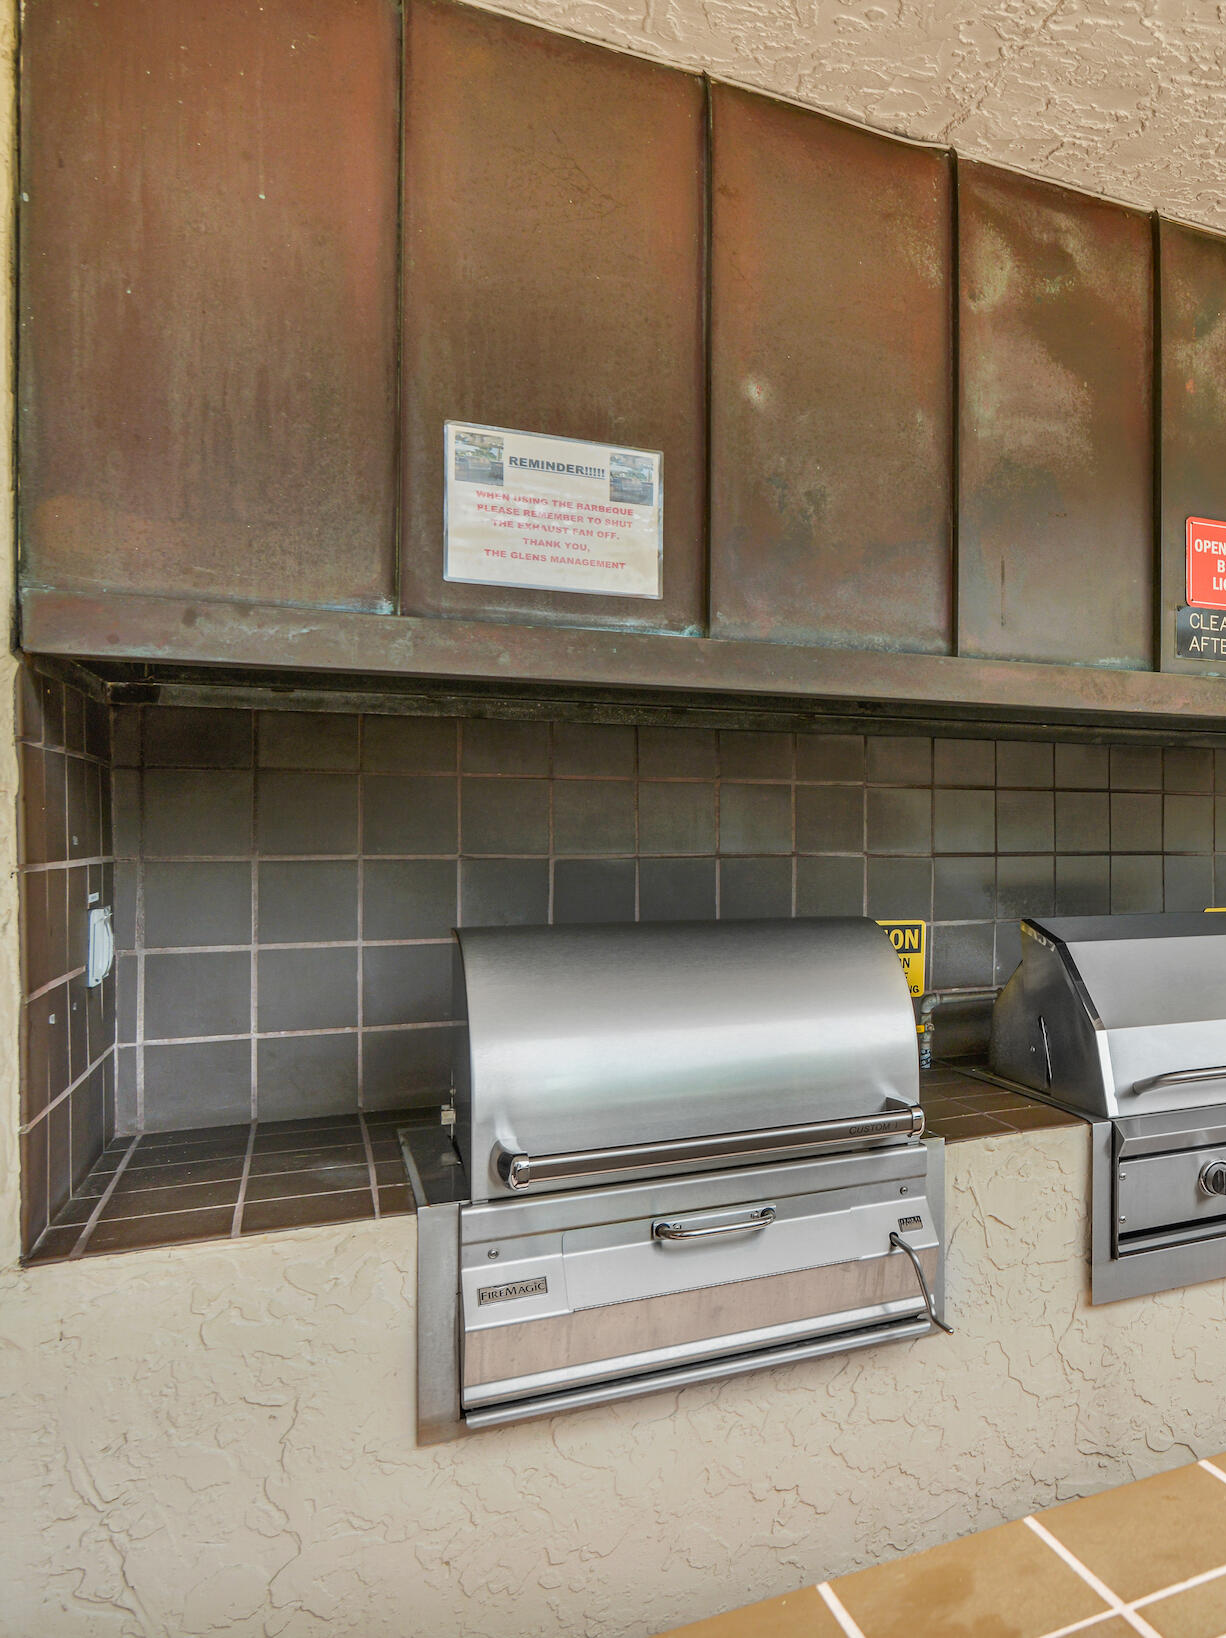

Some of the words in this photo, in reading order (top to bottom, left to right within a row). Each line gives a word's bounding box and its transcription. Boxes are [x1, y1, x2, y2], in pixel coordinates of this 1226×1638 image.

[476, 490, 510, 501] WHEN
[513, 495, 548, 505] USING
[552, 499, 574, 509] THE
[576, 502, 634, 516] BARBEQUE
[477, 503, 520, 516] PLEASE
[523, 509, 584, 523] REMEMBER
[587, 516, 602, 525] TO
[605, 518, 632, 528] SHUT
[491, 518, 514, 529] THE
[517, 522, 569, 534] EXHAUST
[572, 527, 594, 537] FAN
[597, 530, 620, 540] OFF.
[522, 537, 562, 548] THANK
[564, 542, 591, 552] YOU,
[1194, 538, 1226, 556] OPEN
[484, 548, 507, 558] THE
[510, 551, 547, 562] GLENS
[550, 555, 626, 570] MANAGEMENT
